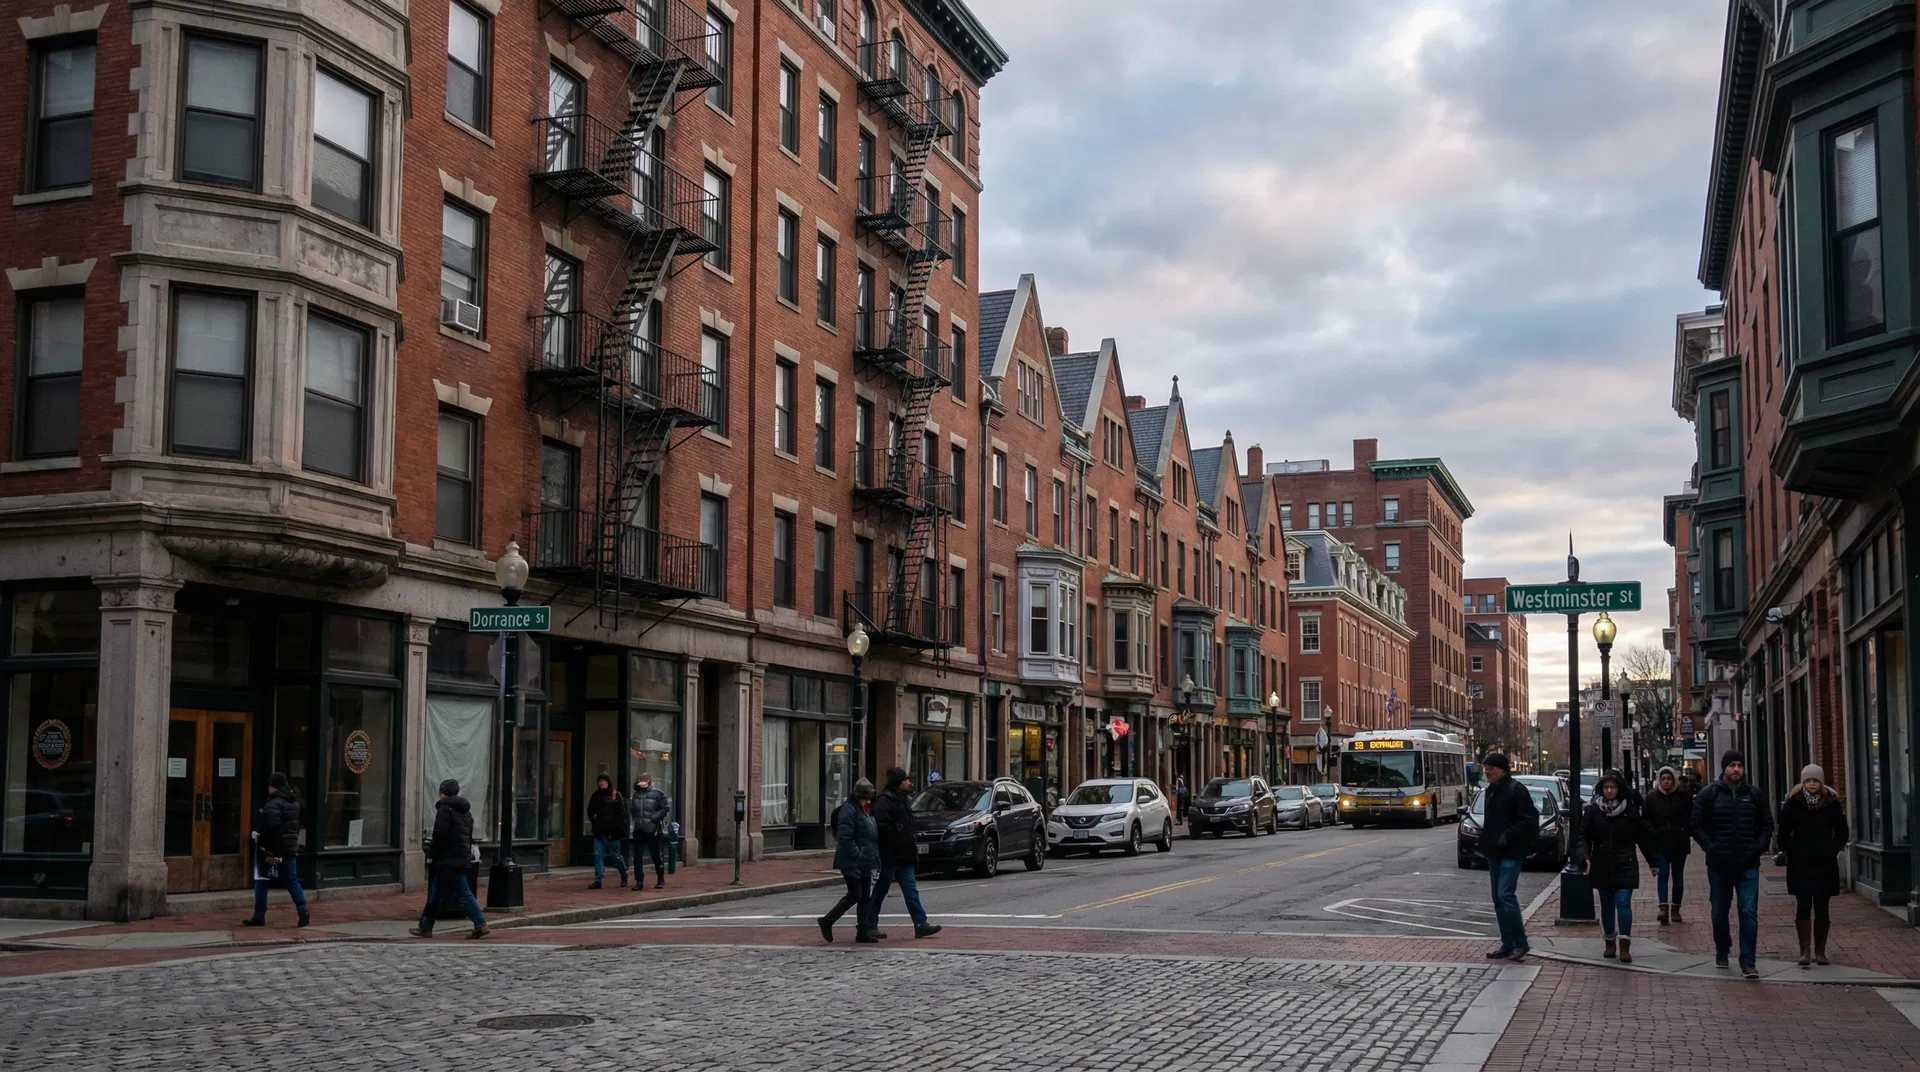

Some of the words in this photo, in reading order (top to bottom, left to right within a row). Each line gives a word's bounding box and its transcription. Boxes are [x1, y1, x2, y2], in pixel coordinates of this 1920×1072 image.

[1512, 588, 1613, 608] Westminster
[1620, 590, 1633, 603] St
[472, 611, 530, 627] Dorrance
[536, 613, 544, 623] St
